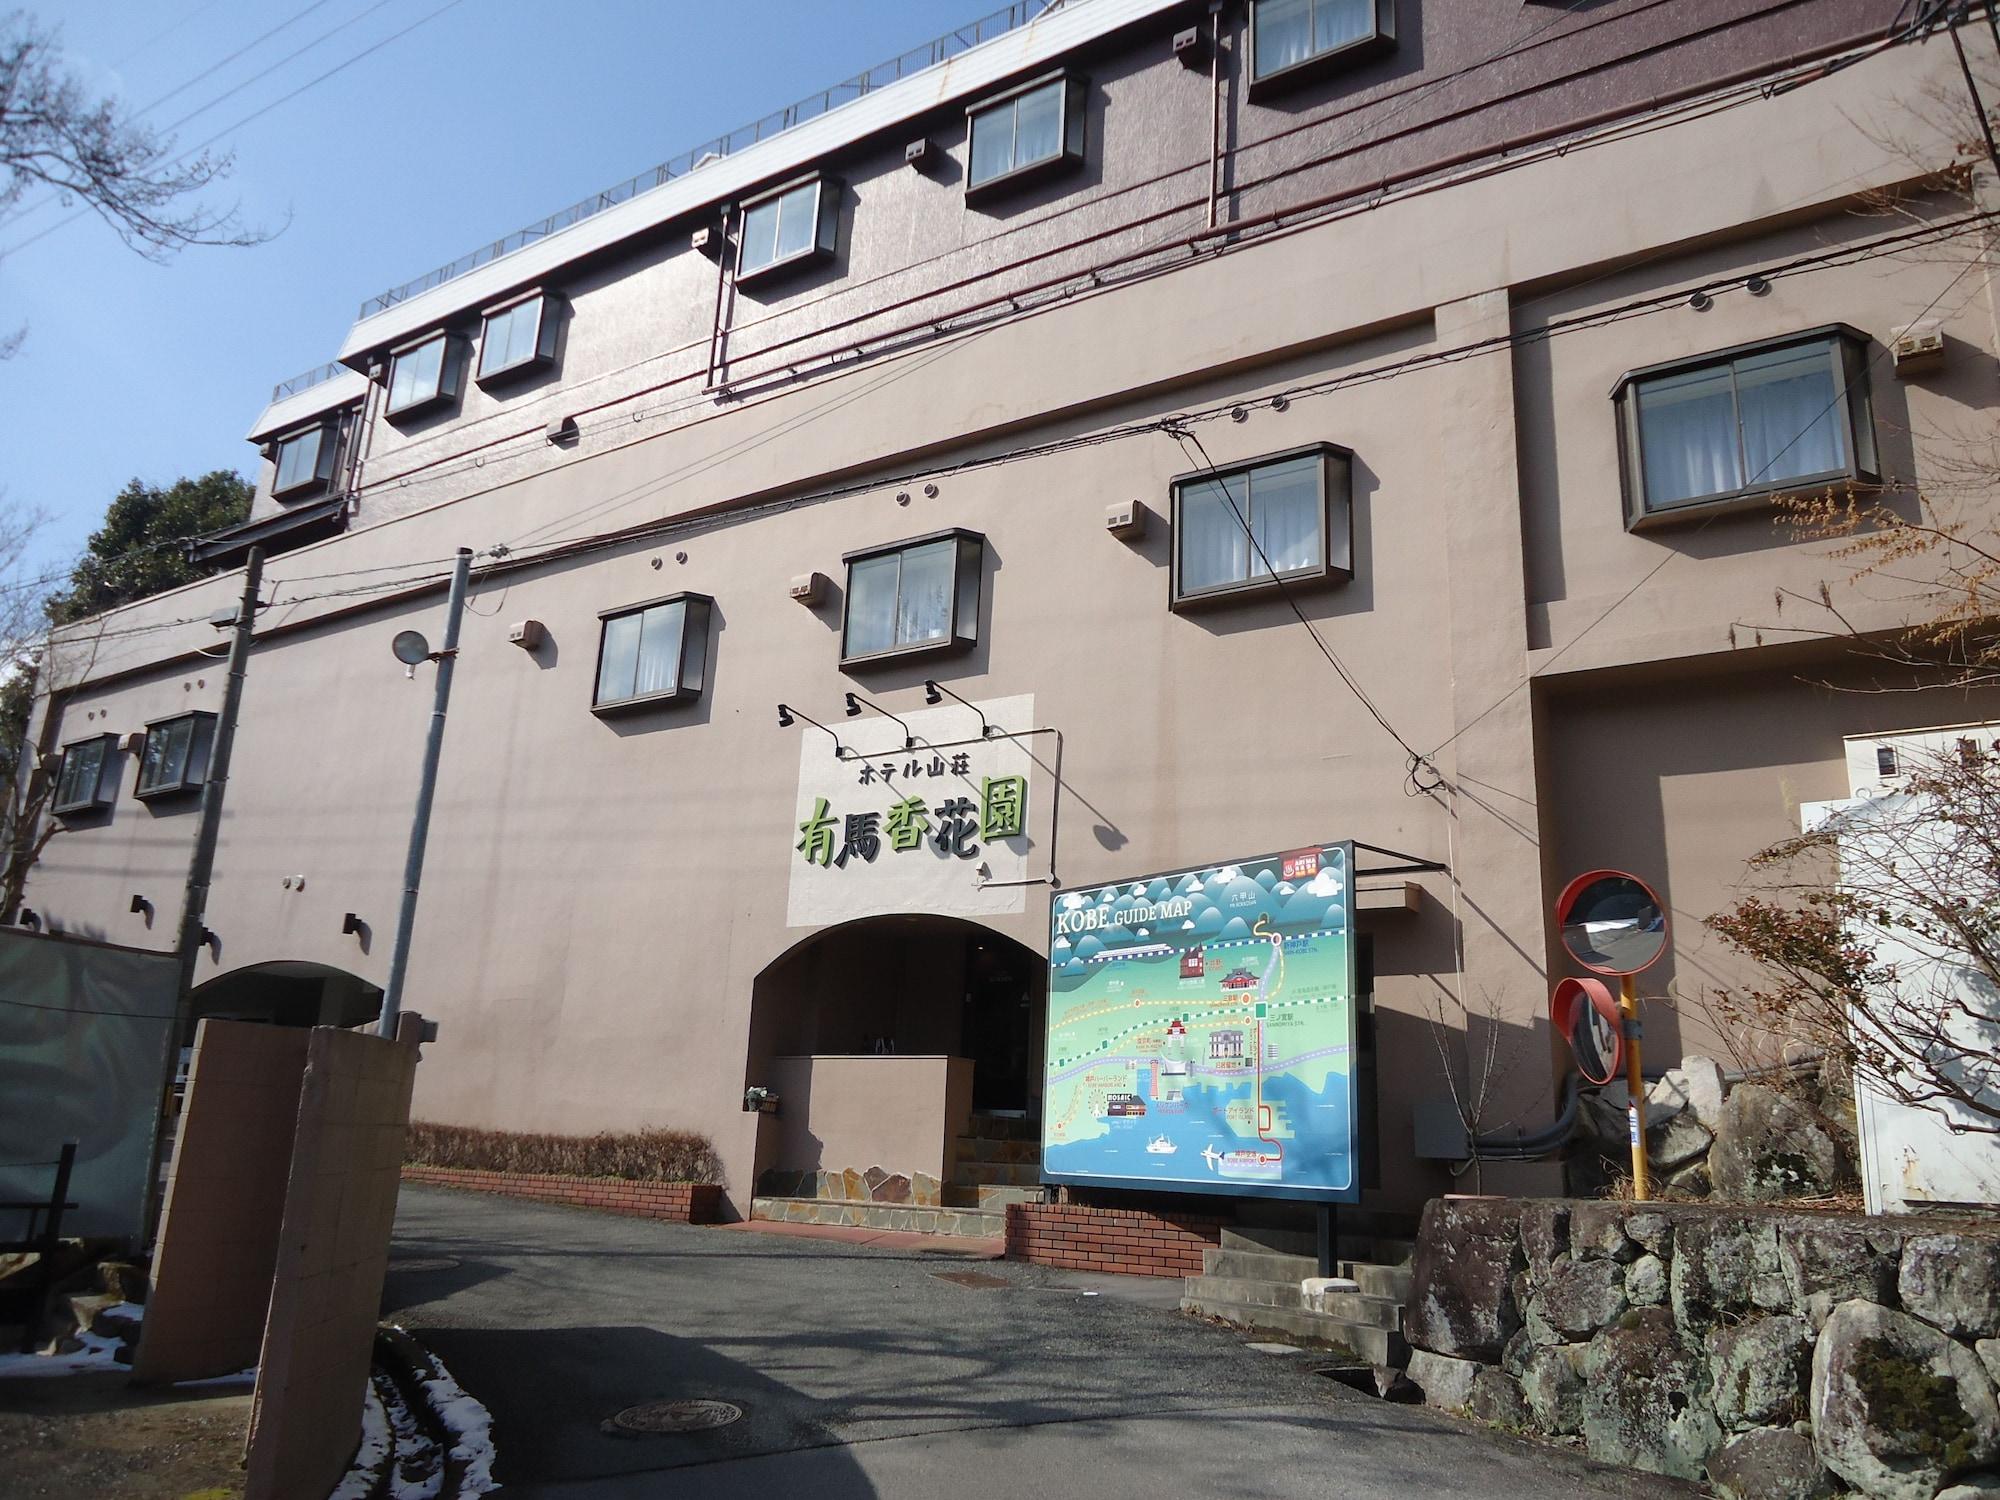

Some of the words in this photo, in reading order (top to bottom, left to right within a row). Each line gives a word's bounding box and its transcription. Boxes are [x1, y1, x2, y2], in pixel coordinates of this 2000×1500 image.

[858, 752, 971, 785] ホテル山荘
[796, 775, 1028, 869] 有馬香花園
[1056, 906, 1110, 934] KOBE
[1114, 905, 1157, 926] GUIDE
[1160, 900, 1193, 920] MAP
